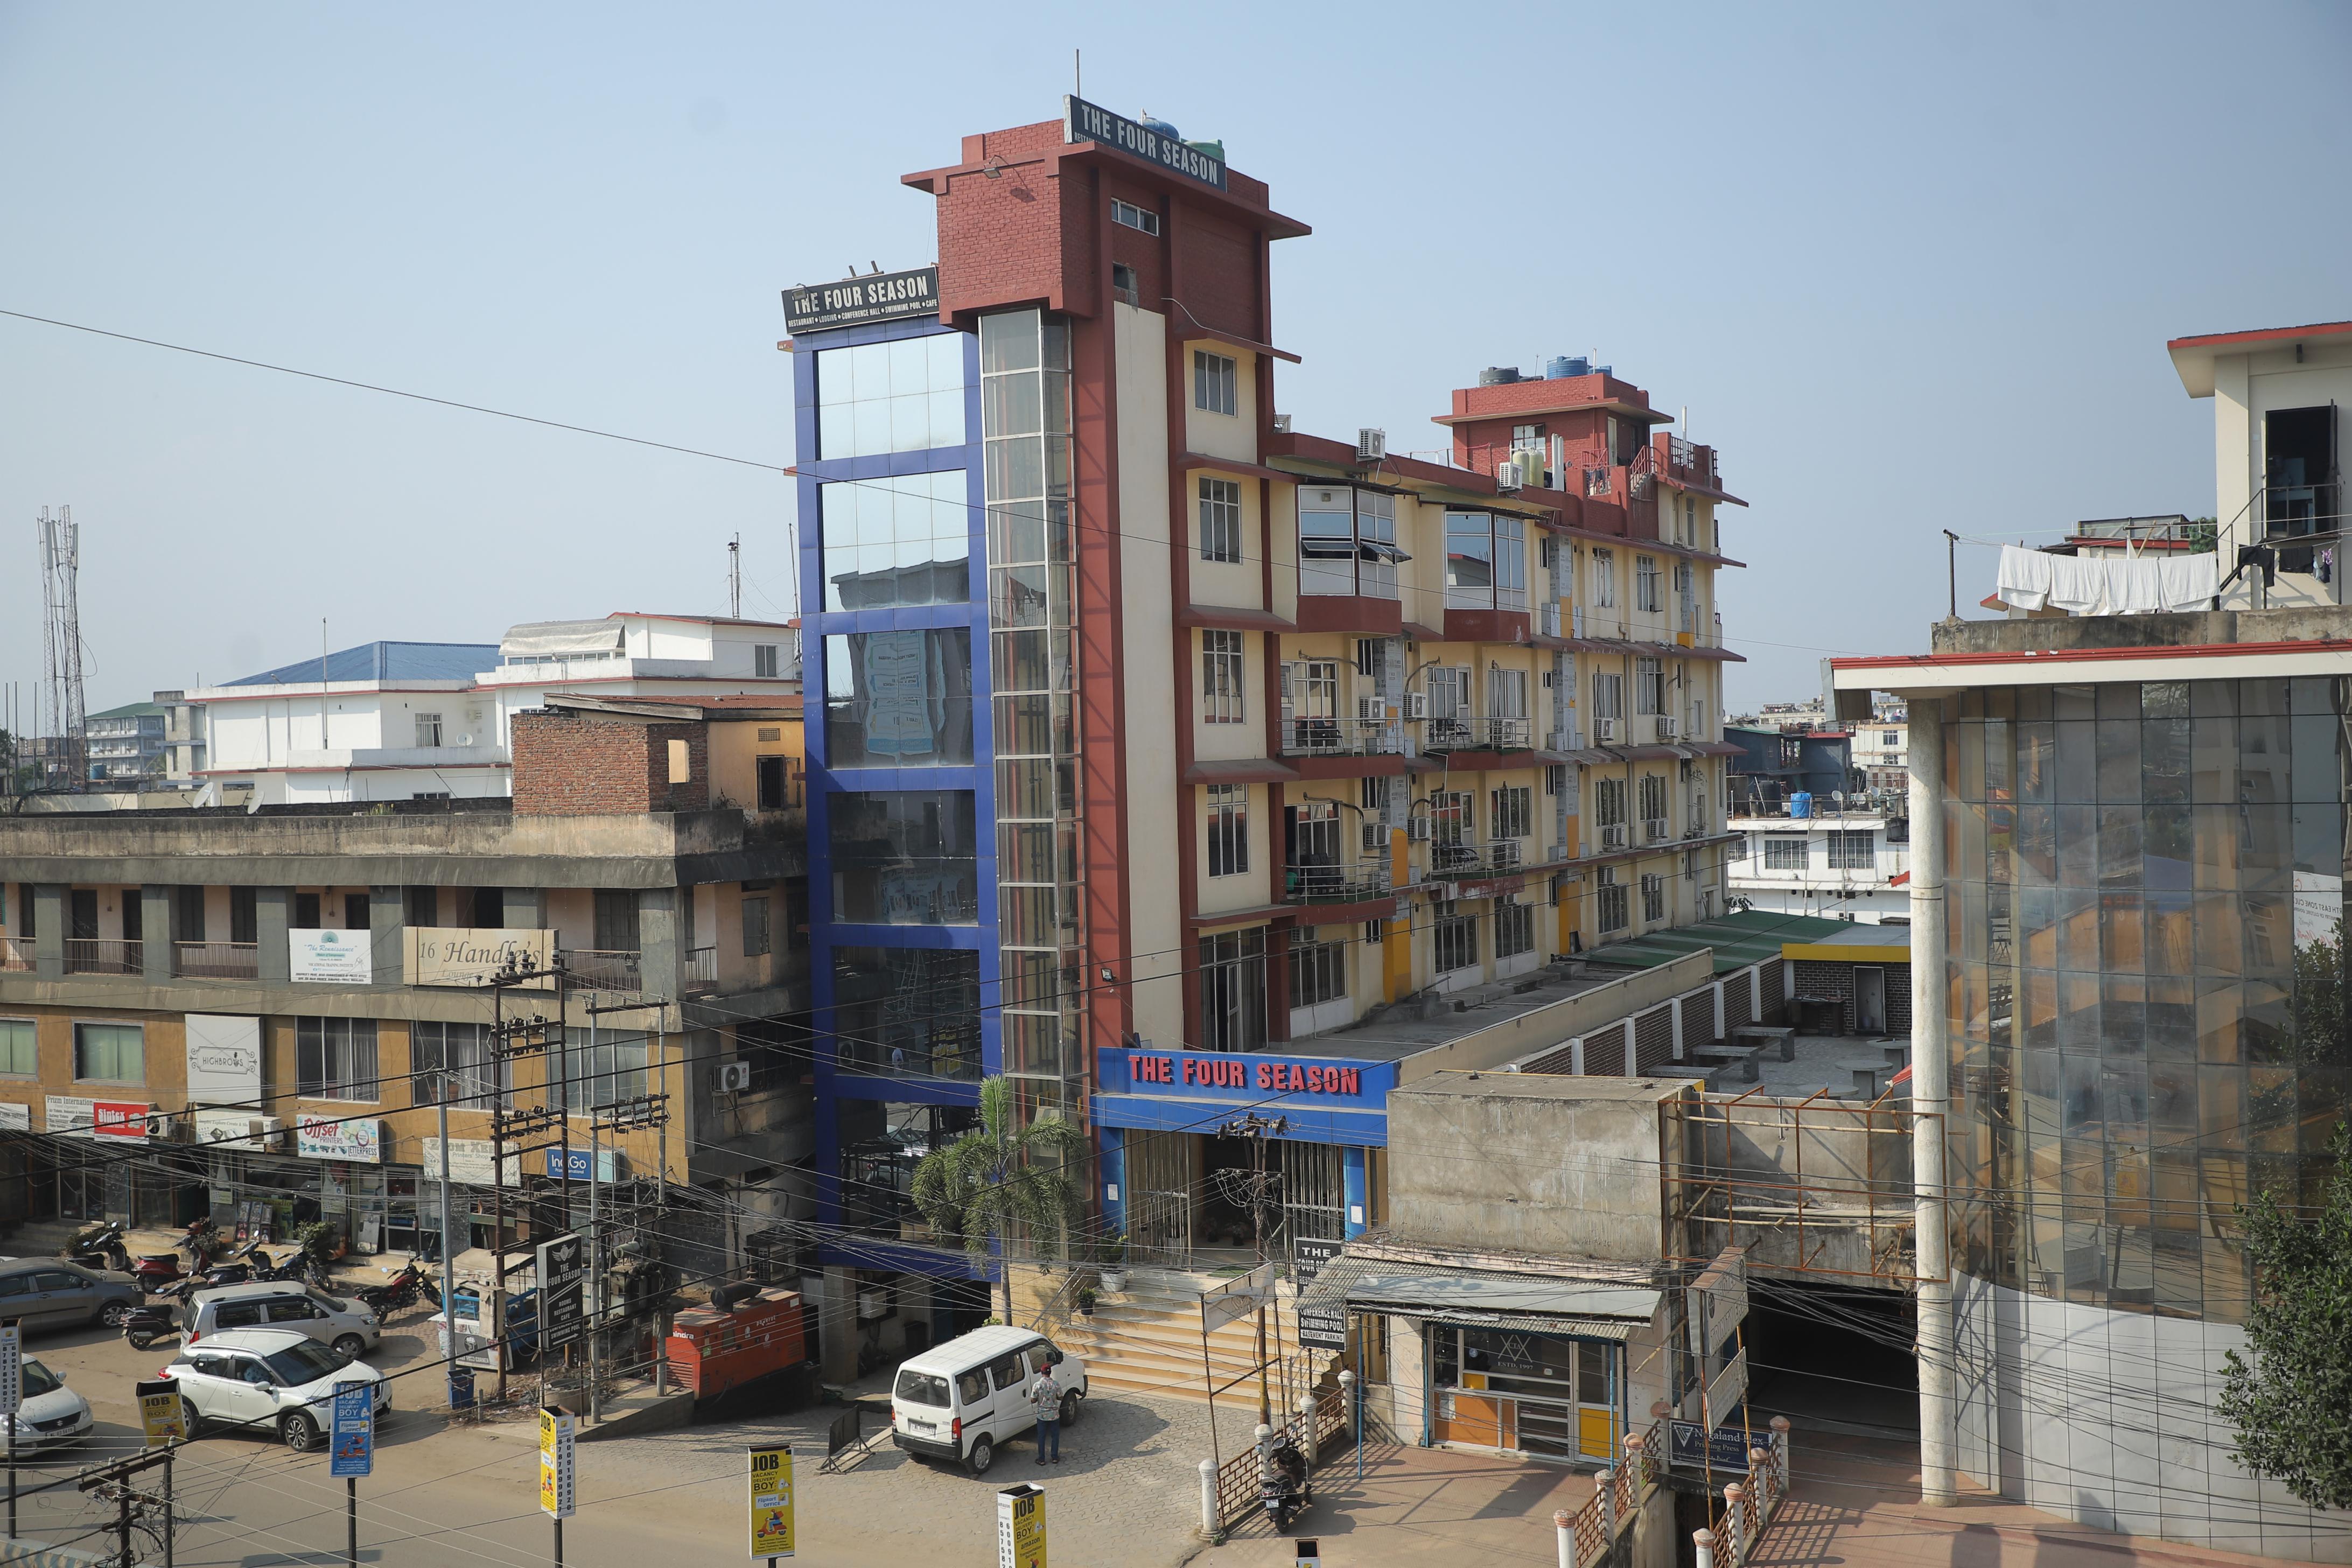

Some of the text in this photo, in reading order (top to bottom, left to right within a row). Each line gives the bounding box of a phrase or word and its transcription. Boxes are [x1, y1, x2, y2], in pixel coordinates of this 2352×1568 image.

[1082, 104, 1217, 185] THE FOUR SEASON
[793, 276, 928, 314] THE FOUR SEASON
[788, 299, 937, 327] RESTAURANT LODGING CONFERENCE HALL SWIMMING POOL CAFE
[419, 942, 435, 958] 16
[442, 969, 473, 981] Lounge
[202, 1056, 243, 1067] HIGHBROWS
[1128, 1055, 1359, 1094] THE FOUR SEASON
[47, 1096, 62, 1104] Prizm
[64, 1097, 94, 1108] Internation
[98, 1108, 125, 1123] Sintex
[304, 1117, 339, 1138] Offset
[320, 1136, 344, 1144] PRINTERS
[430, 1139, 513, 1154] ZOM XERX
[348, 1146, 377, 1157] LETTERPRESS
[551, 1154, 586, 1169] InGo
[1301, 1247, 1331, 1258] THE
[561, 1263, 569, 1273] THE
[1297, 1258, 1314, 1272] FOUR
[548, 1268, 581, 1287] FOUR SEASON
[559, 1298, 571, 1307] ROOMS
[554, 1303, 576, 1316] RESTAURANT
[1331, 1310, 1343, 1319] HALL
[561, 1313, 570, 1321] CAFE
[551, 1323, 580, 1339] SWIMMING POOL
[1300, 1317, 1343, 1332] SWIMMING POOL
[673, 1331, 694, 1339] indra
[1303, 1331, 1342, 1341] BASEMENT PARKING
[338, 1384, 363, 1399] JOB
[145, 1397, 170, 1407] JOB
[541, 1413, 551, 1432] JOB
[1695, 1428, 1740, 1443] Ngaland
[1695, 1441, 1722, 1451] Priting
[752, 1454, 779, 1472] JOB
[754, 1482, 774, 1490] BOY
[1014, 1497, 1035, 1520] JOB
[1015, 1515, 1034, 1525] VACANCY
[1016, 1521, 1032, 1531] DELIVERY
[1017, 1527, 1032, 1539] BOY
[1021, 1537, 1040, 1550] amazon
[1020, 1545, 1042, 1557] Transportation
